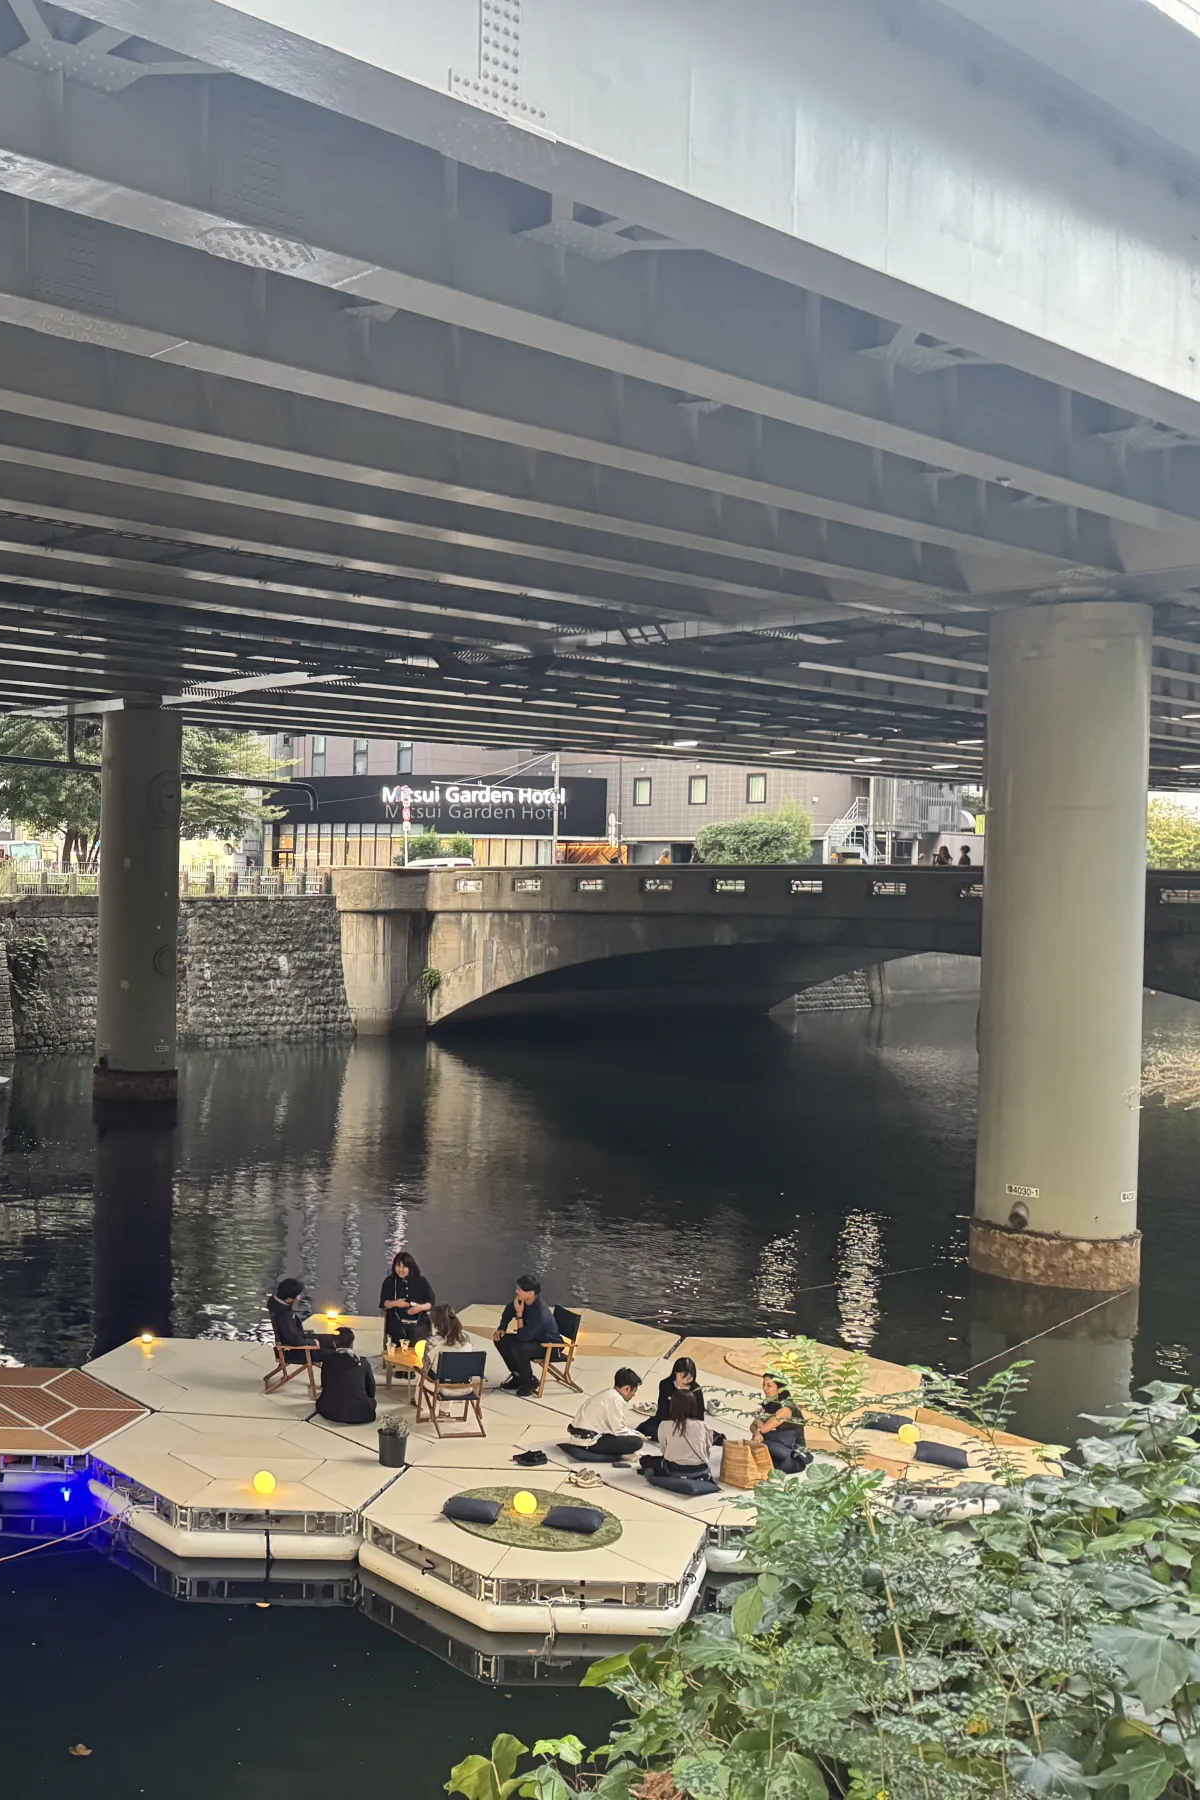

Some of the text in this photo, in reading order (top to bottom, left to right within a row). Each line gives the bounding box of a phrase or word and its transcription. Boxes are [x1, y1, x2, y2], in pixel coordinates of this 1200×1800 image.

[446, 786, 514, 804] Garden
[519, 787, 565, 805] Hotel
[385, 803, 567, 820] Mtsui Garden Hotl
